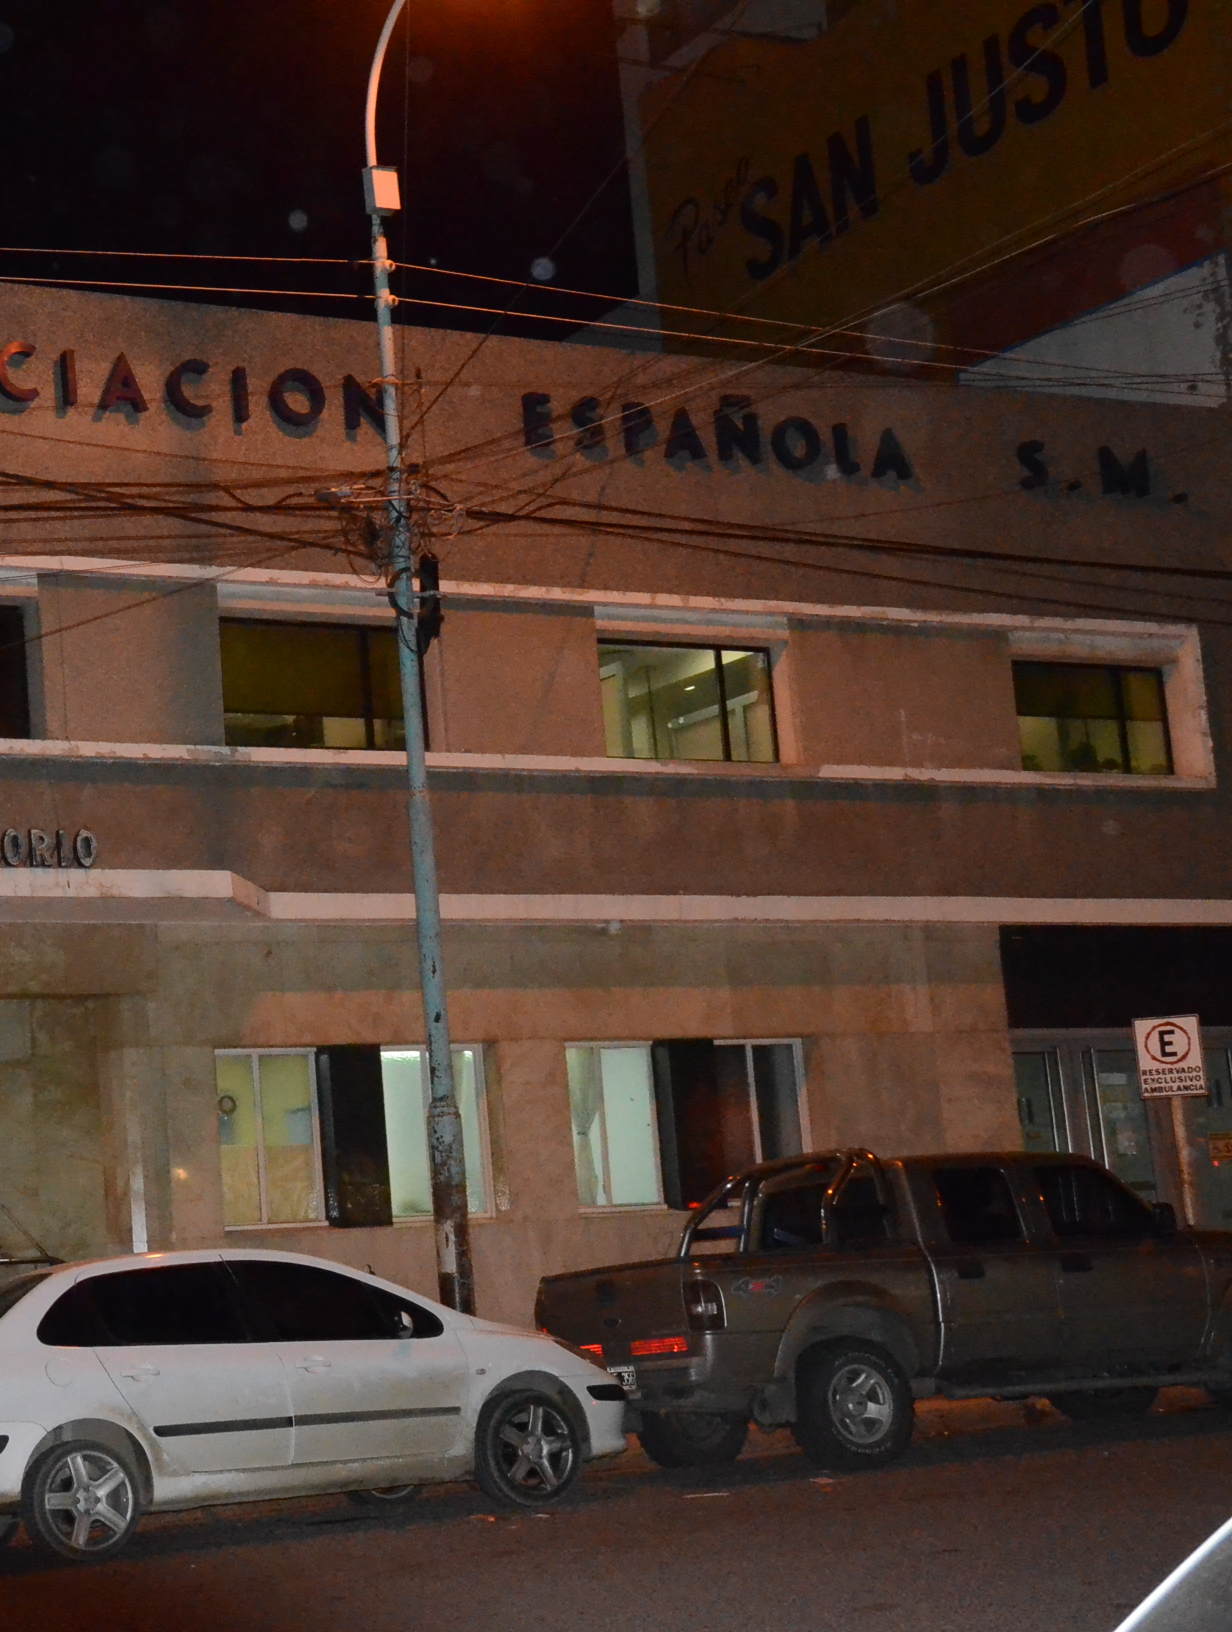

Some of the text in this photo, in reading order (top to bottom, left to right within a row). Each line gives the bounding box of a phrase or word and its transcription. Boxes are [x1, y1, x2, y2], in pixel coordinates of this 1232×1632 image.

[740, 113, 879, 280] SAN
[521, 391, 912, 481] ESPAÑOLA
[1158, 1029, 1178, 1057] E
[1141, 1065, 1201, 1076] RESERVADO
[1143, 1074, 1202, 1085] EXCLUSIVO
[1143, 1084, 1204, 1094] AMBULANCIA
